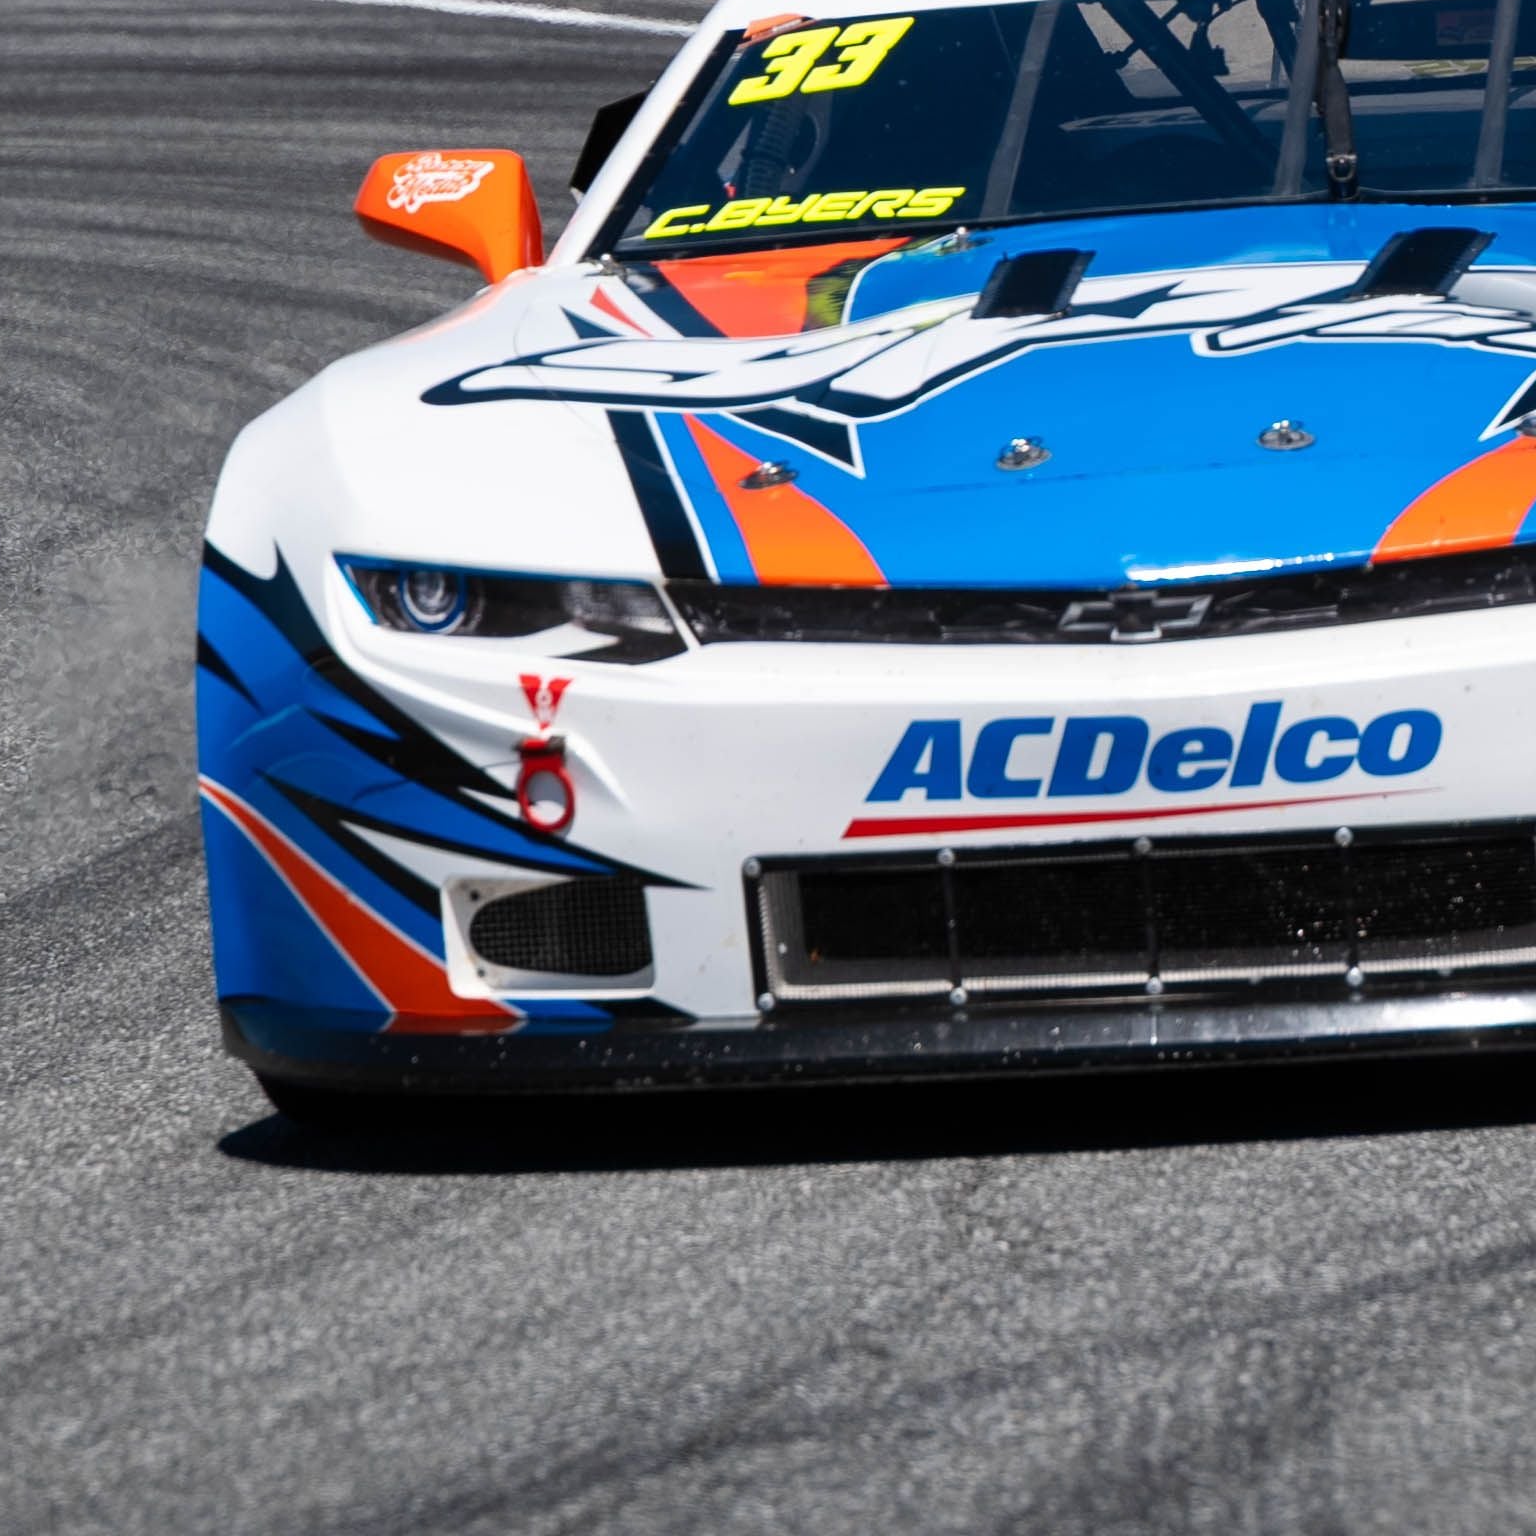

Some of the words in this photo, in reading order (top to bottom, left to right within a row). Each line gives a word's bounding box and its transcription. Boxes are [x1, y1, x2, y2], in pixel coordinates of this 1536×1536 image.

[727, 16, 916, 106] 33
[642, 186, 967, 240] C.BYERS
[864, 700, 1443, 804] ACDelco
